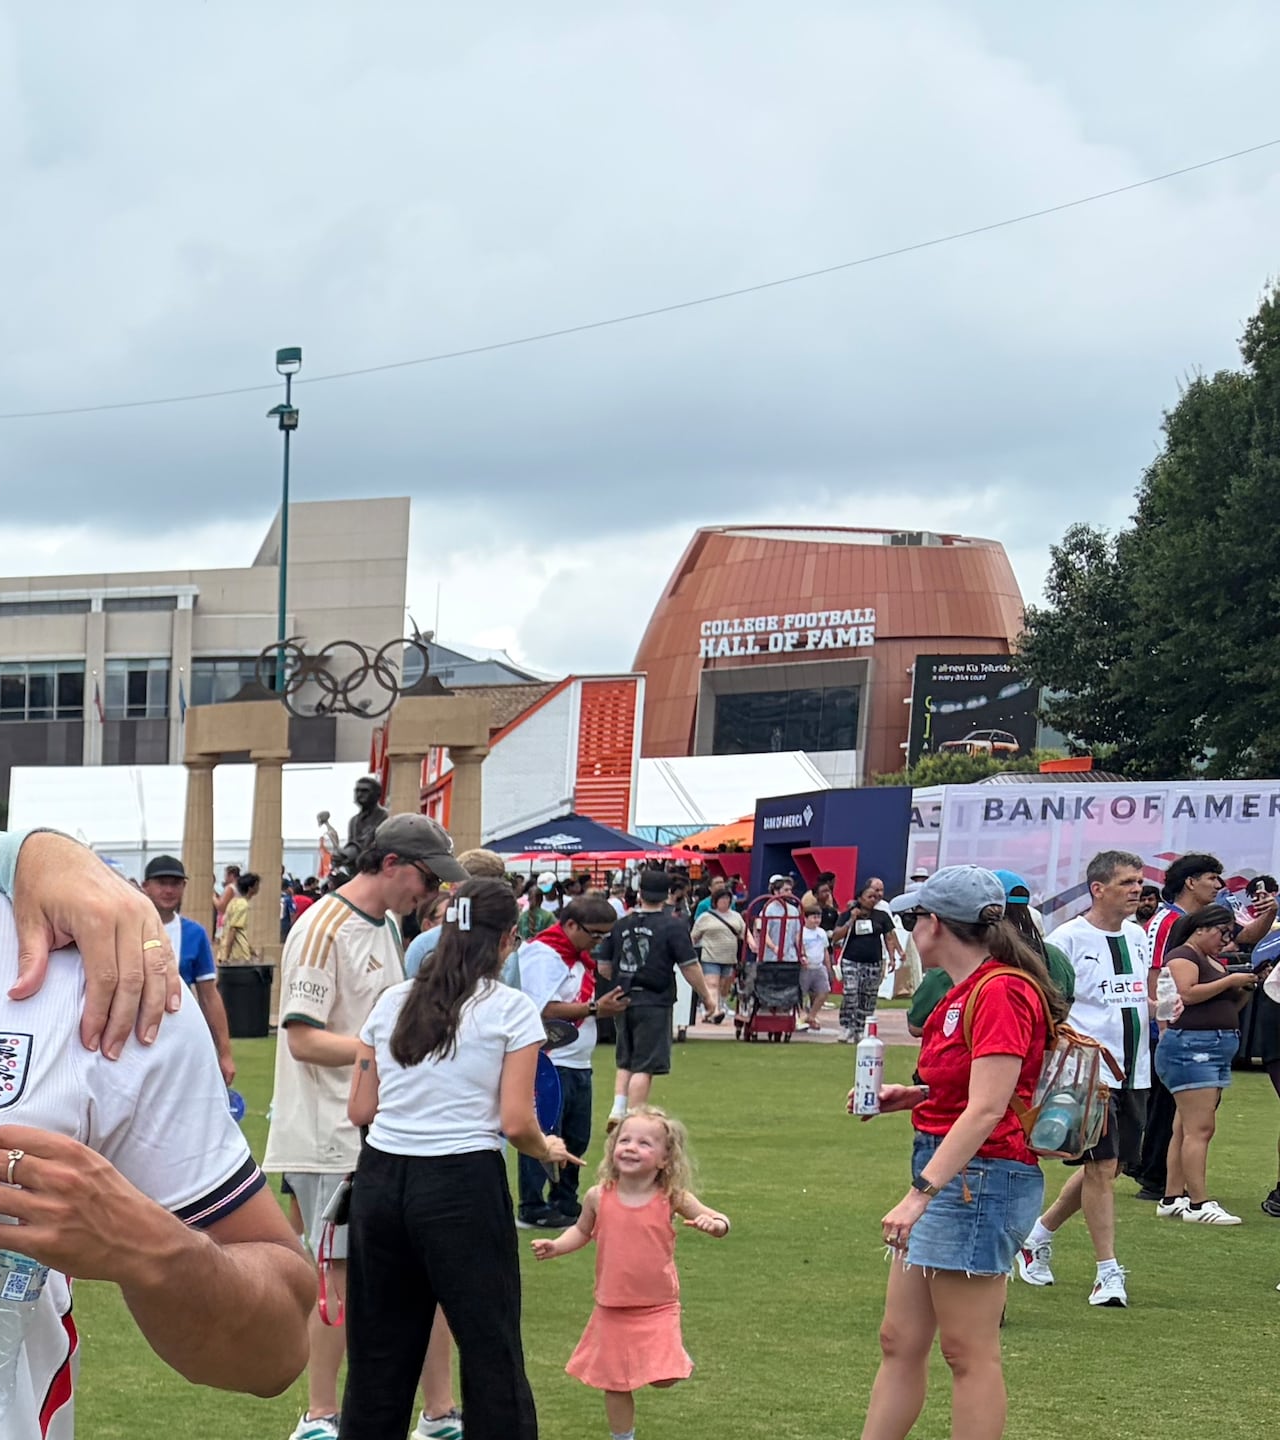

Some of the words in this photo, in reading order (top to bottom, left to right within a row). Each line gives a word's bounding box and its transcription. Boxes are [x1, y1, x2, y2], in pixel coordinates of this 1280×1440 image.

[700, 615, 779, 636] COLLEGE
[783, 608, 876, 630] FOOTBALL
[698, 634, 760, 659] HALL
[768, 631, 800, 653] OF
[805, 625, 876, 650] FAME
[983, 795, 1096, 821] BANK
[1110, 795, 1162, 819] OF
[1172, 793, 1280, 819] AMER
[763, 816, 776, 830] BANK
[782, 814, 803, 828] AMERICA
